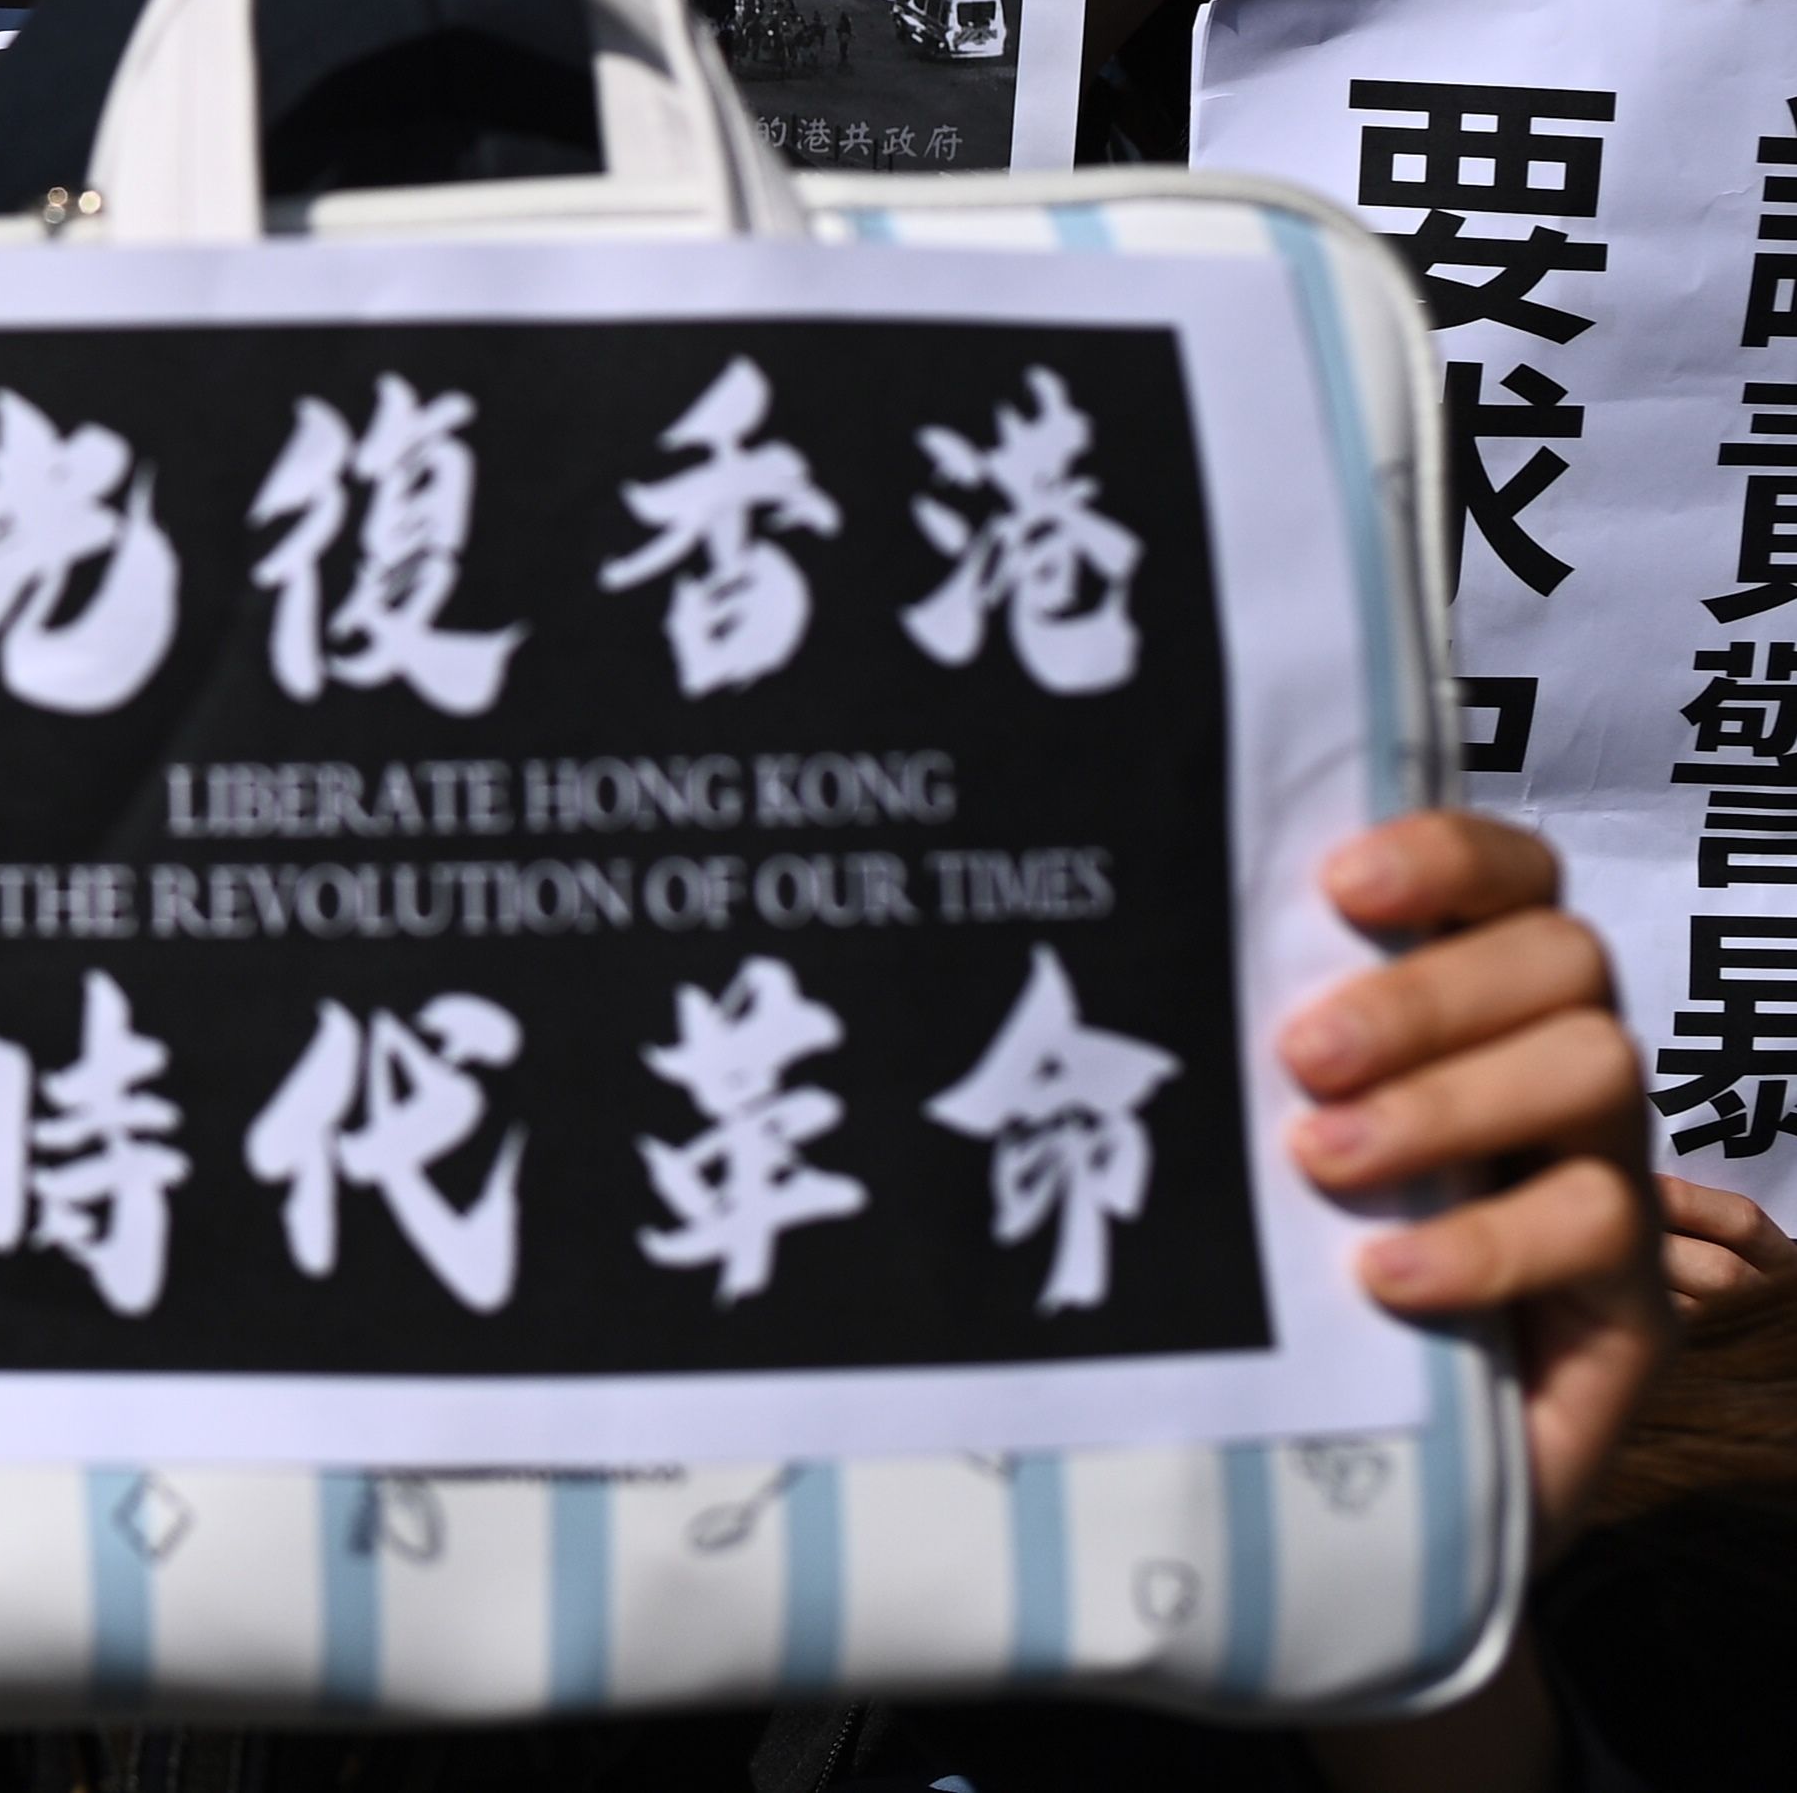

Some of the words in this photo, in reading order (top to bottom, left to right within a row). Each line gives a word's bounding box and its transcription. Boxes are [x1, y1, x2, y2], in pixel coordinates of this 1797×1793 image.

[164, 759, 512, 838] LIBERATE
[524, 754, 742, 834] HONG
[755, 749, 958, 826] KONG
[148, 856, 634, 941] REVOLUTION
[643, 854, 746, 930] OF
[752, 852, 914, 928] OUR
[921, 846, 1117, 923] TIMES
